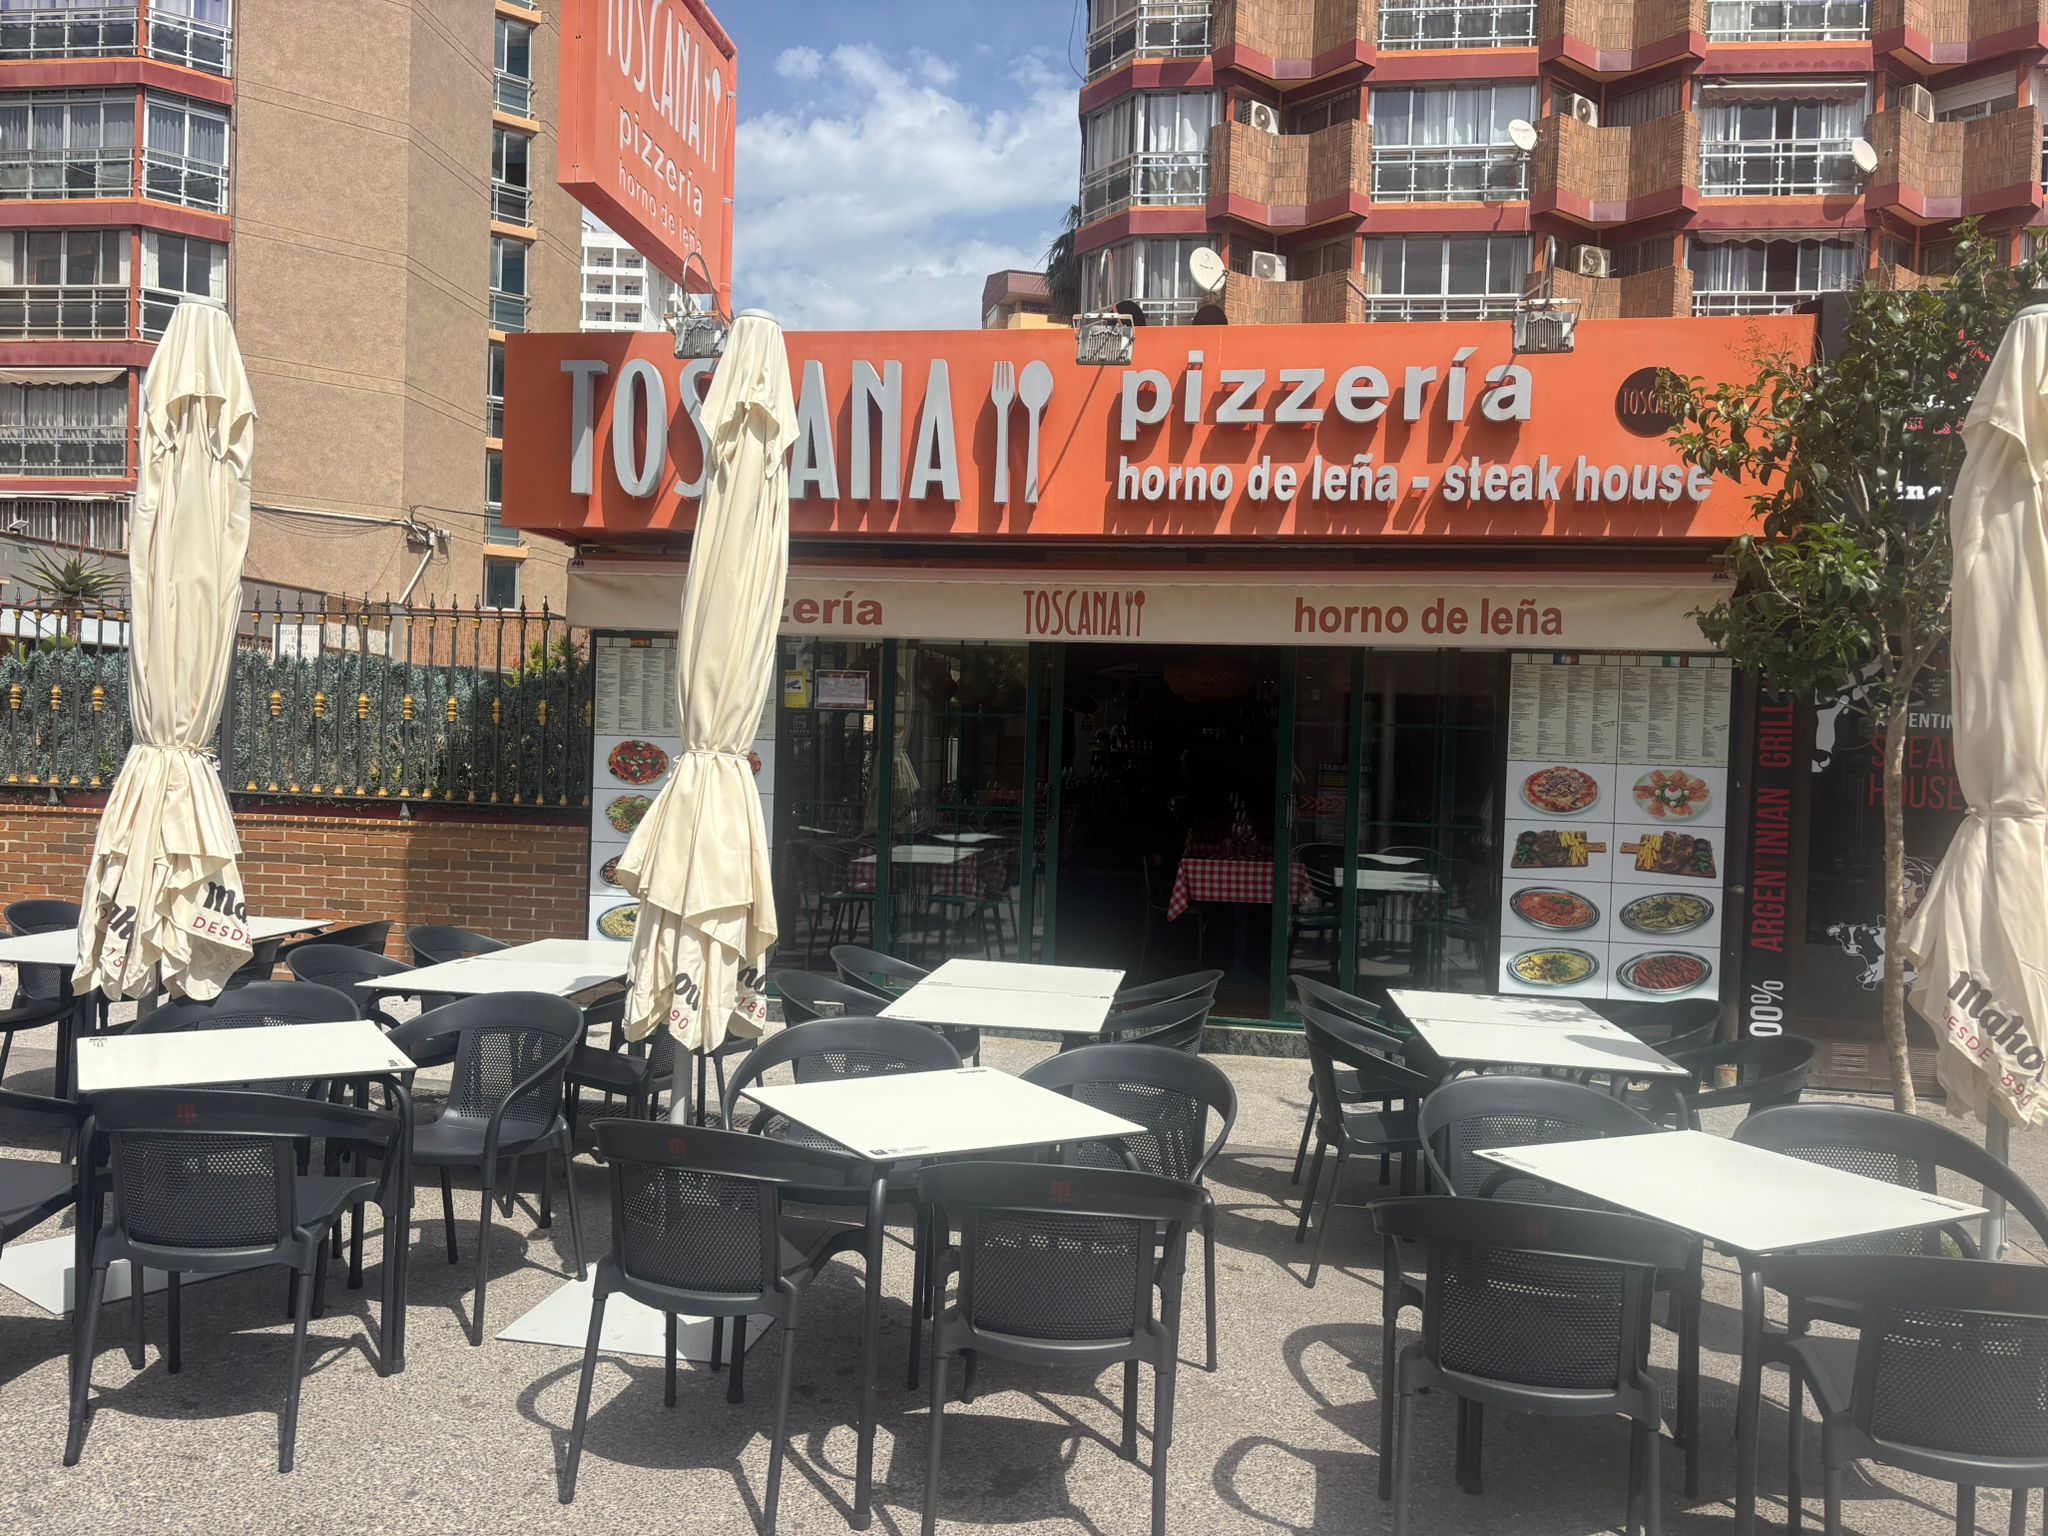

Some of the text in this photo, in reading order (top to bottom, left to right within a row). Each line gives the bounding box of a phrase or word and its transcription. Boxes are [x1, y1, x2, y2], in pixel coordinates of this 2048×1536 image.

[619, 157, 657, 217] horno
[661, 201, 676, 234] de
[1120, 346, 1533, 441] pizzería
[560, 358, 962, 502] TOSANA
[1117, 455, 1233, 501] horno
[1247, 455, 1297, 501] de
[1311, 453, 1398, 502] leña
[1442, 456, 1560, 502] steak
[1574, 456, 1713, 503] house
[781, 590, 883, 625] ería
[1022, 590, 1121, 636] TOSCANA
[1294, 596, 1563, 635] horno de leña
[1759, 700, 1795, 768] GRILL
[1871, 735, 1955, 770] SEA
[1751, 787, 1791, 952] ARGENTINIAN
[670, 1009, 689, 1030] 90
[738, 996, 766, 1019] 189
[1749, 979, 1784, 1037] 00%
[1946, 970, 2045, 1083] Maho
[2001, 1073, 2033, 1106] 890
